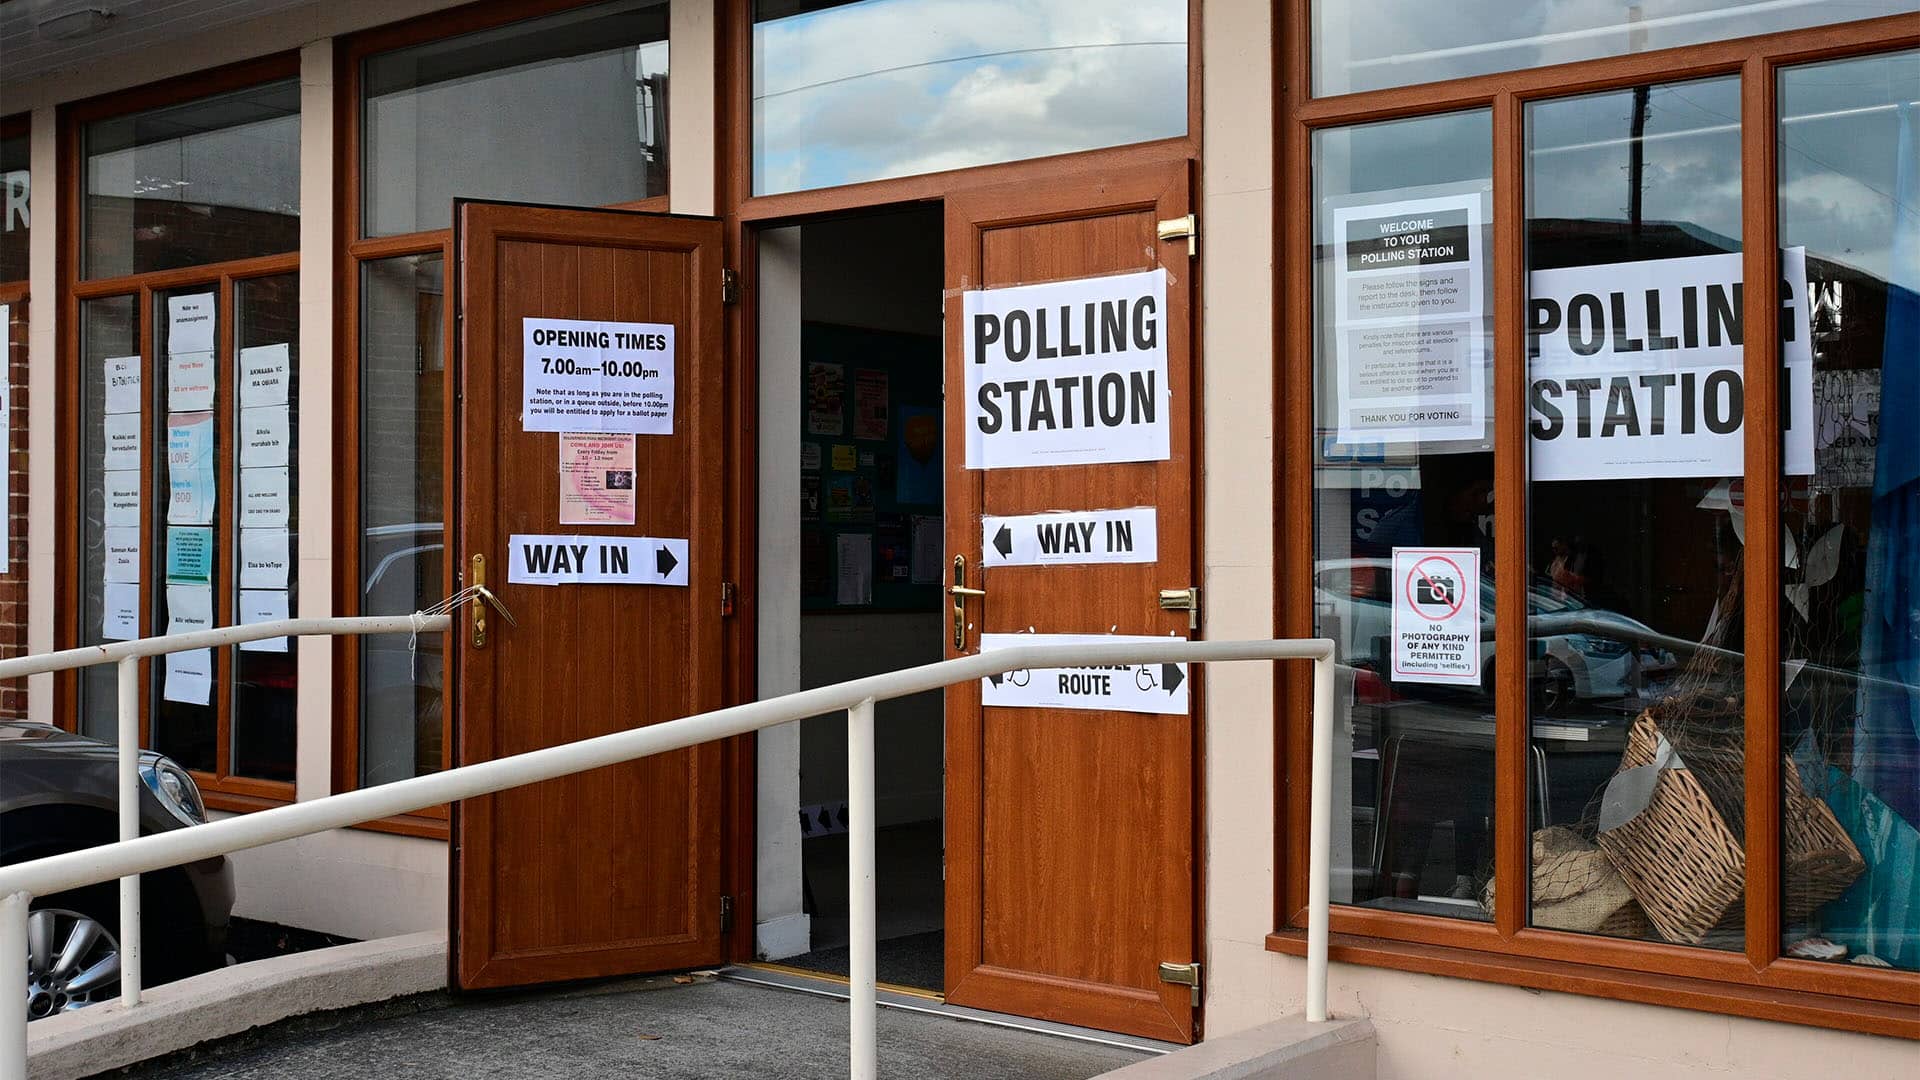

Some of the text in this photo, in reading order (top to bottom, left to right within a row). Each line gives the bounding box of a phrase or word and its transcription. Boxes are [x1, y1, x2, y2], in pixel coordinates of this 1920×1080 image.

[1380, 219, 1434, 233] WELCOME
[1384, 234, 1430, 247] TO YOUR
[1361, 246, 1453, 264] POLLING STATION
[1420, 279, 1438, 288] signs
[1372, 301, 1409, 310] instructions
[1411, 299, 1430, 308] given
[1440, 298, 1456, 306] you.
[974, 296, 1157, 364] POLLING
[533, 329, 666, 351] OPENING TIMES
[642, 392, 663, 400] polling
[978, 370, 1156, 434] STATION
[170, 452, 190, 463] LOVE
[172, 480, 184, 488] there
[175, 492, 191, 503] GOD
[1037, 520, 1133, 554] WAY IN
[523, 544, 629, 574] WAY IN
[1402, 633, 1470, 641] PHOTOGRAPHY
[1410, 652, 1462, 660] PERMITTED
[1402, 661, 1438, 669] (including
[1058, 674, 1111, 696] ROUTE
